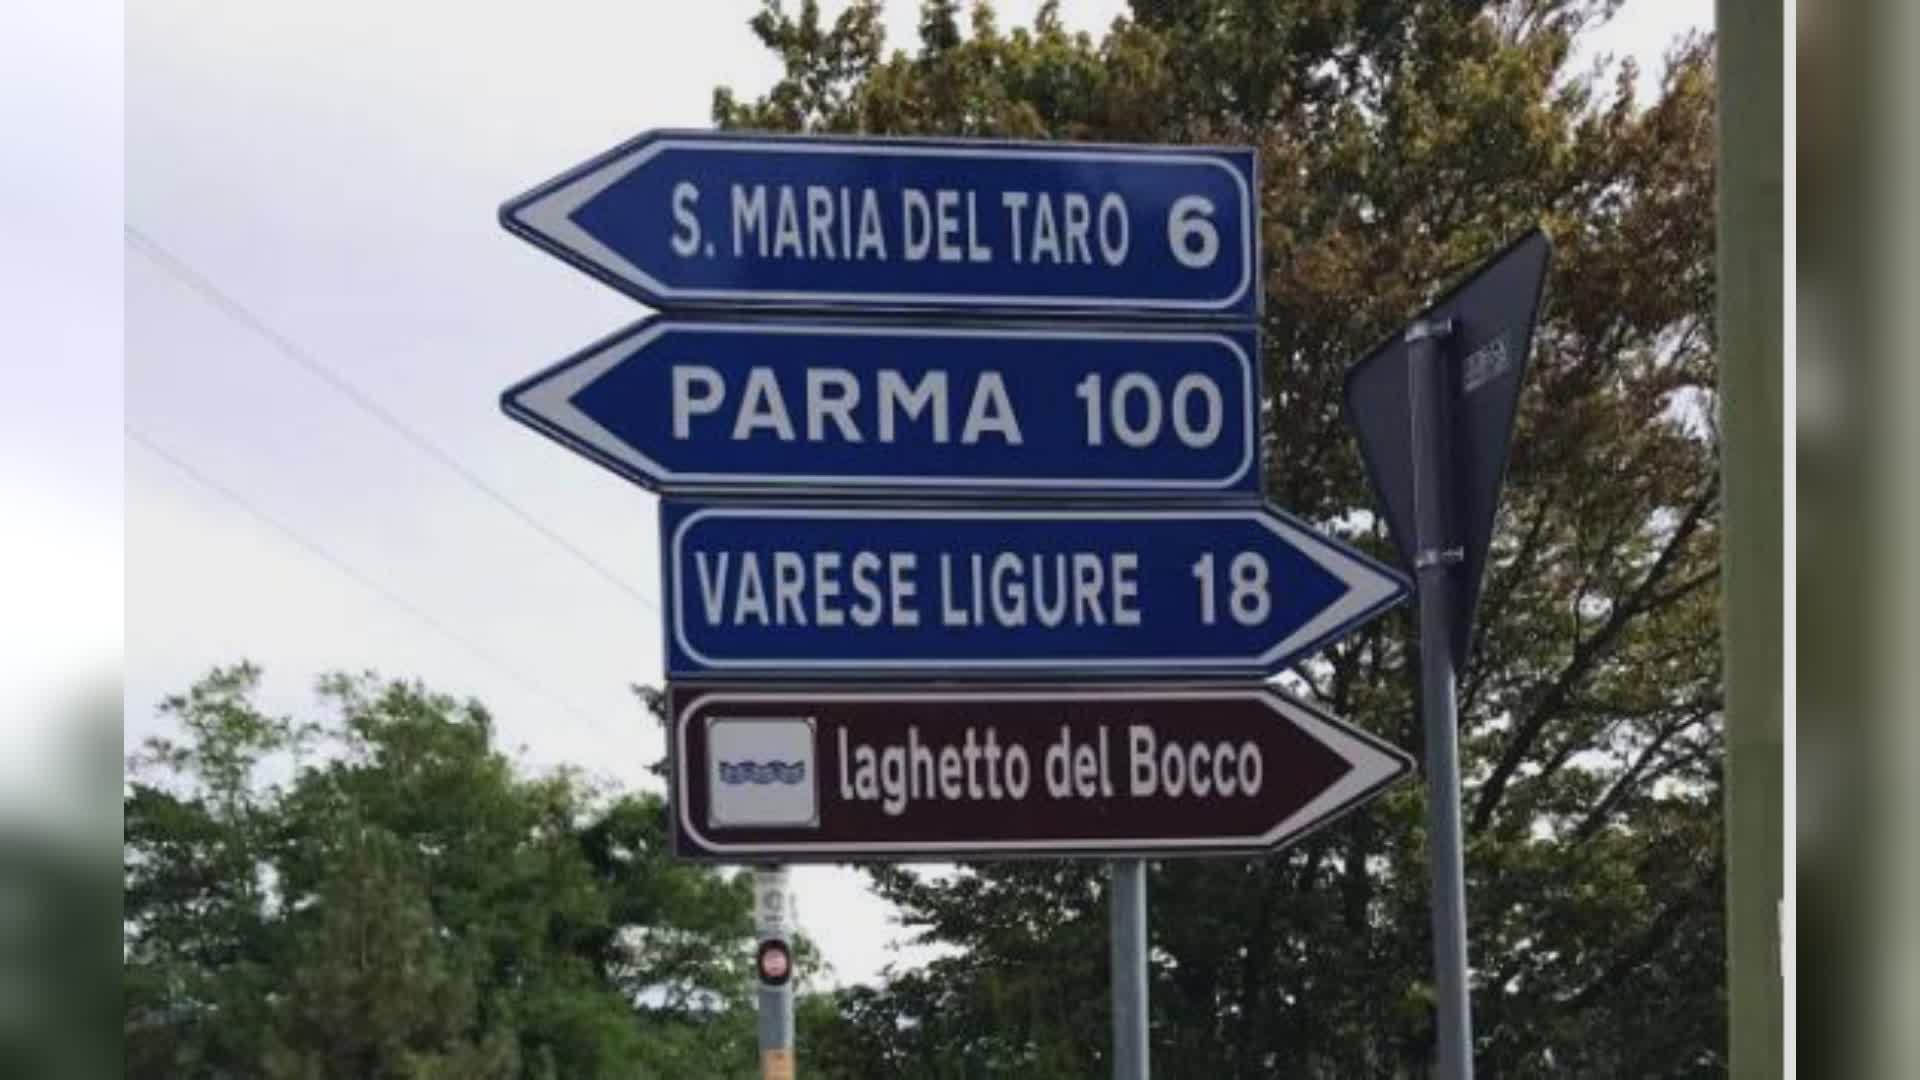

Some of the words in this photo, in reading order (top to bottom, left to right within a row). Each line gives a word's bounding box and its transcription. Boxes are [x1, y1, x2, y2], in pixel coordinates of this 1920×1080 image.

[671, 182, 715, 257] S.
[732, 185, 887, 261] MARIA
[903, 190, 992, 261] DEL
[1003, 192, 1129, 266] TARO
[1167, 196, 1219, 268] 6
[672, 365, 1023, 445] PARMA
[1076, 372, 1224, 447] 100
[696, 551, 919, 626] VARESE
[941, 552, 1142, 627] LIGURE
[1193, 552, 1271, 626] 18
[838, 726, 1030, 815] laghetto
[1045, 726, 1112, 797] del
[1130, 725, 1262, 797] Bocco
